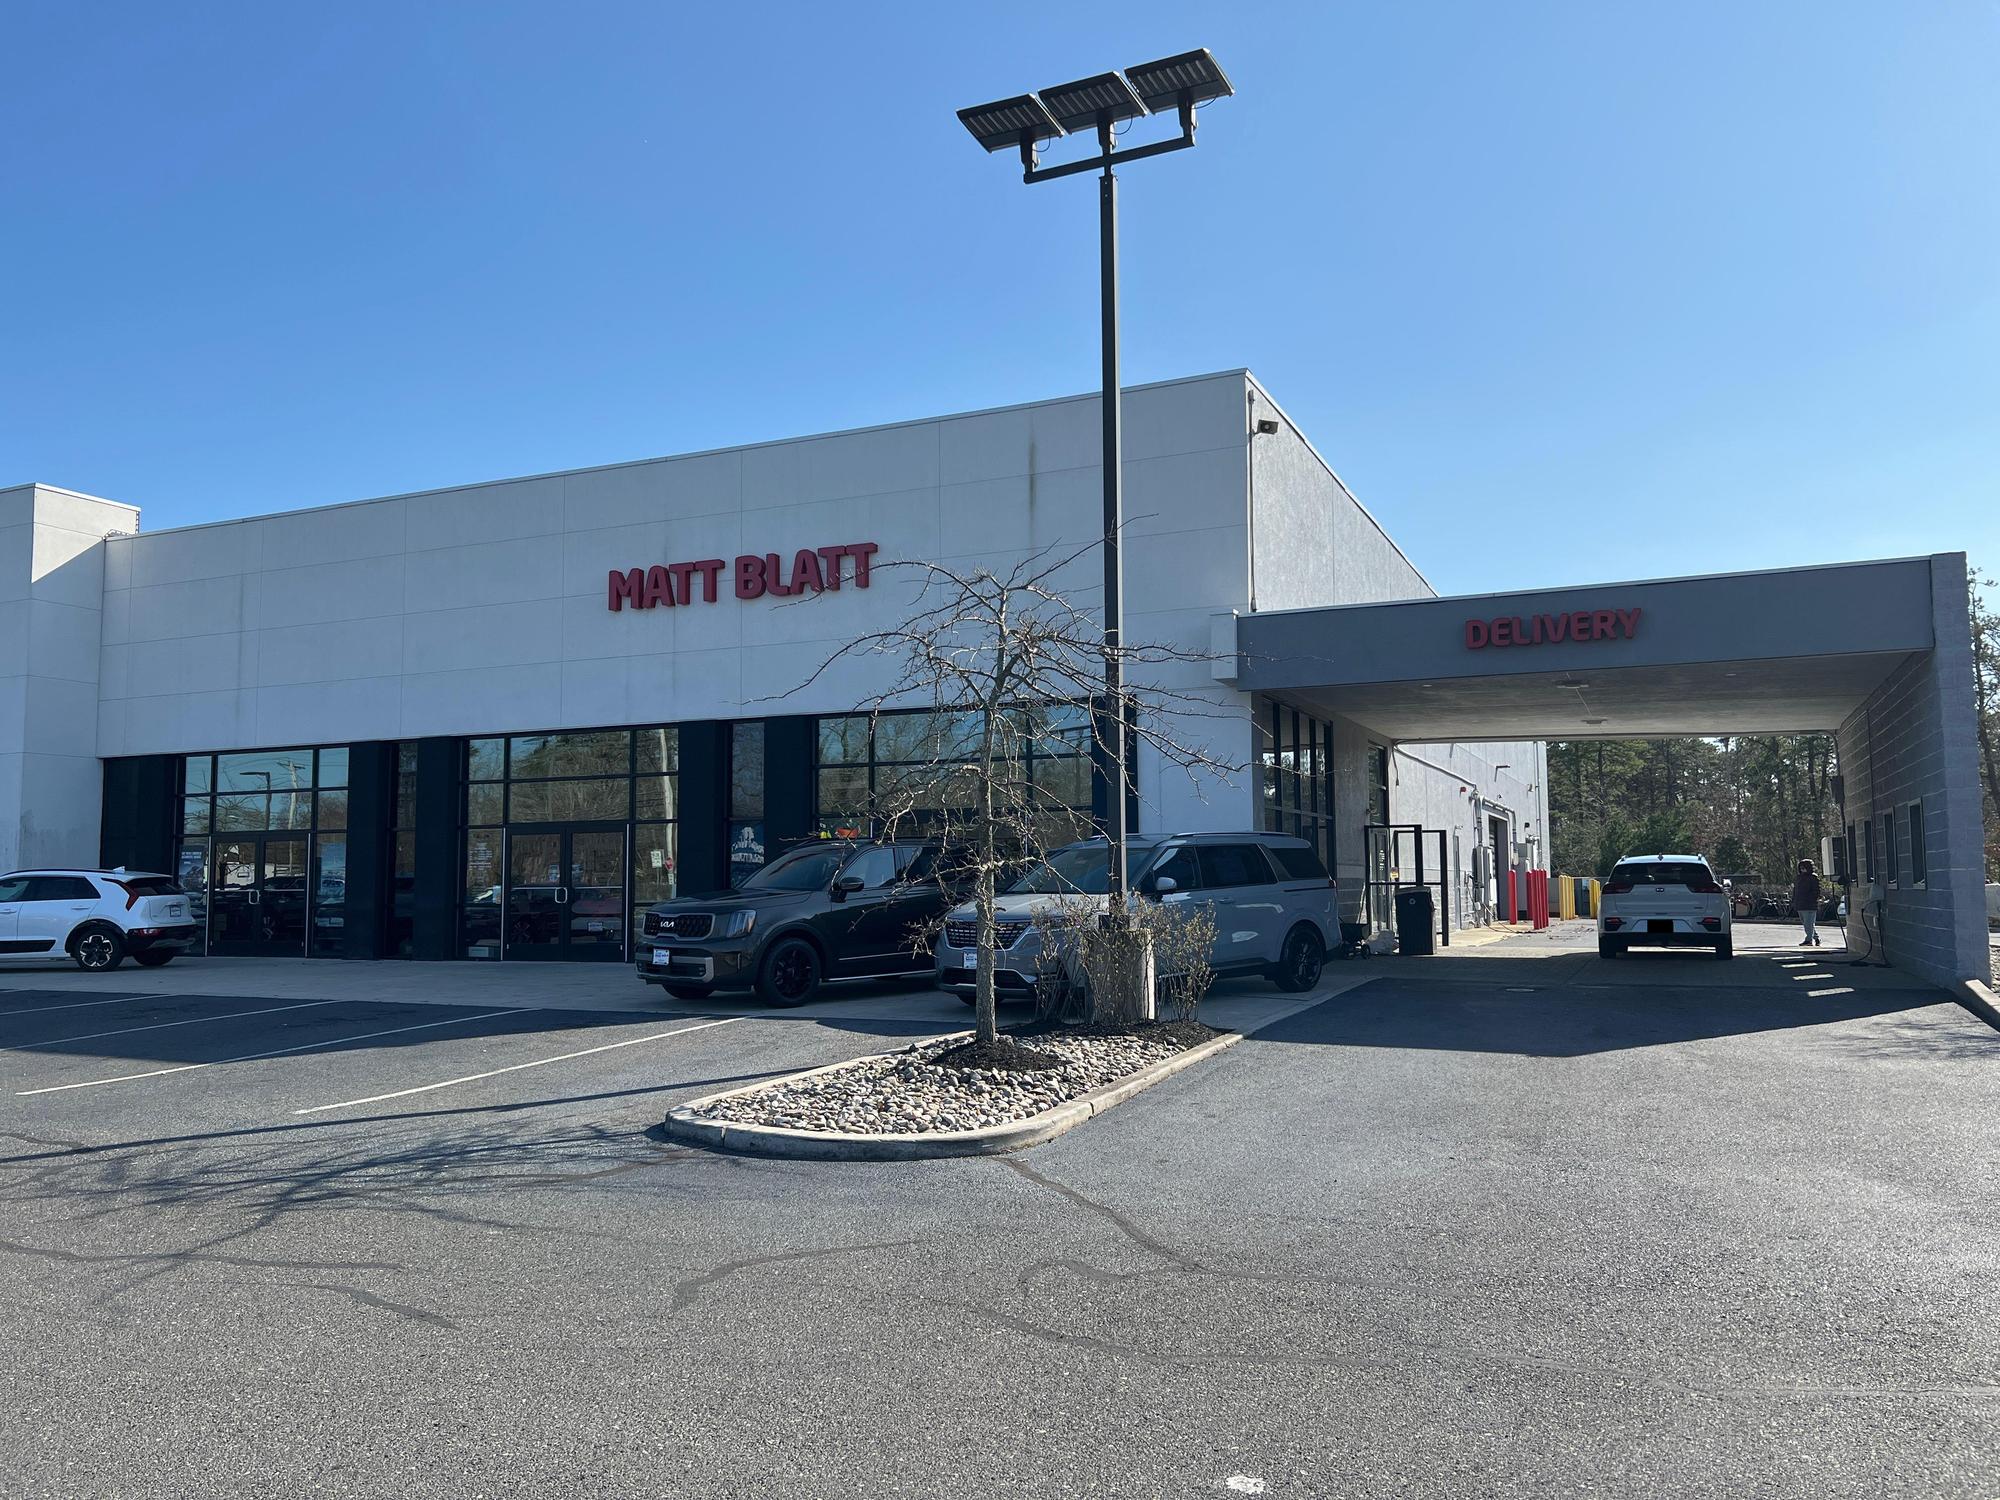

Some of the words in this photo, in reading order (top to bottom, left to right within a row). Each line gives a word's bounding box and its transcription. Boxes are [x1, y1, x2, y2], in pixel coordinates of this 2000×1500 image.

[608, 559, 725, 612] MATT
[735, 542, 878, 601] BLATT
[1465, 607, 1642, 649] DELIVERY
